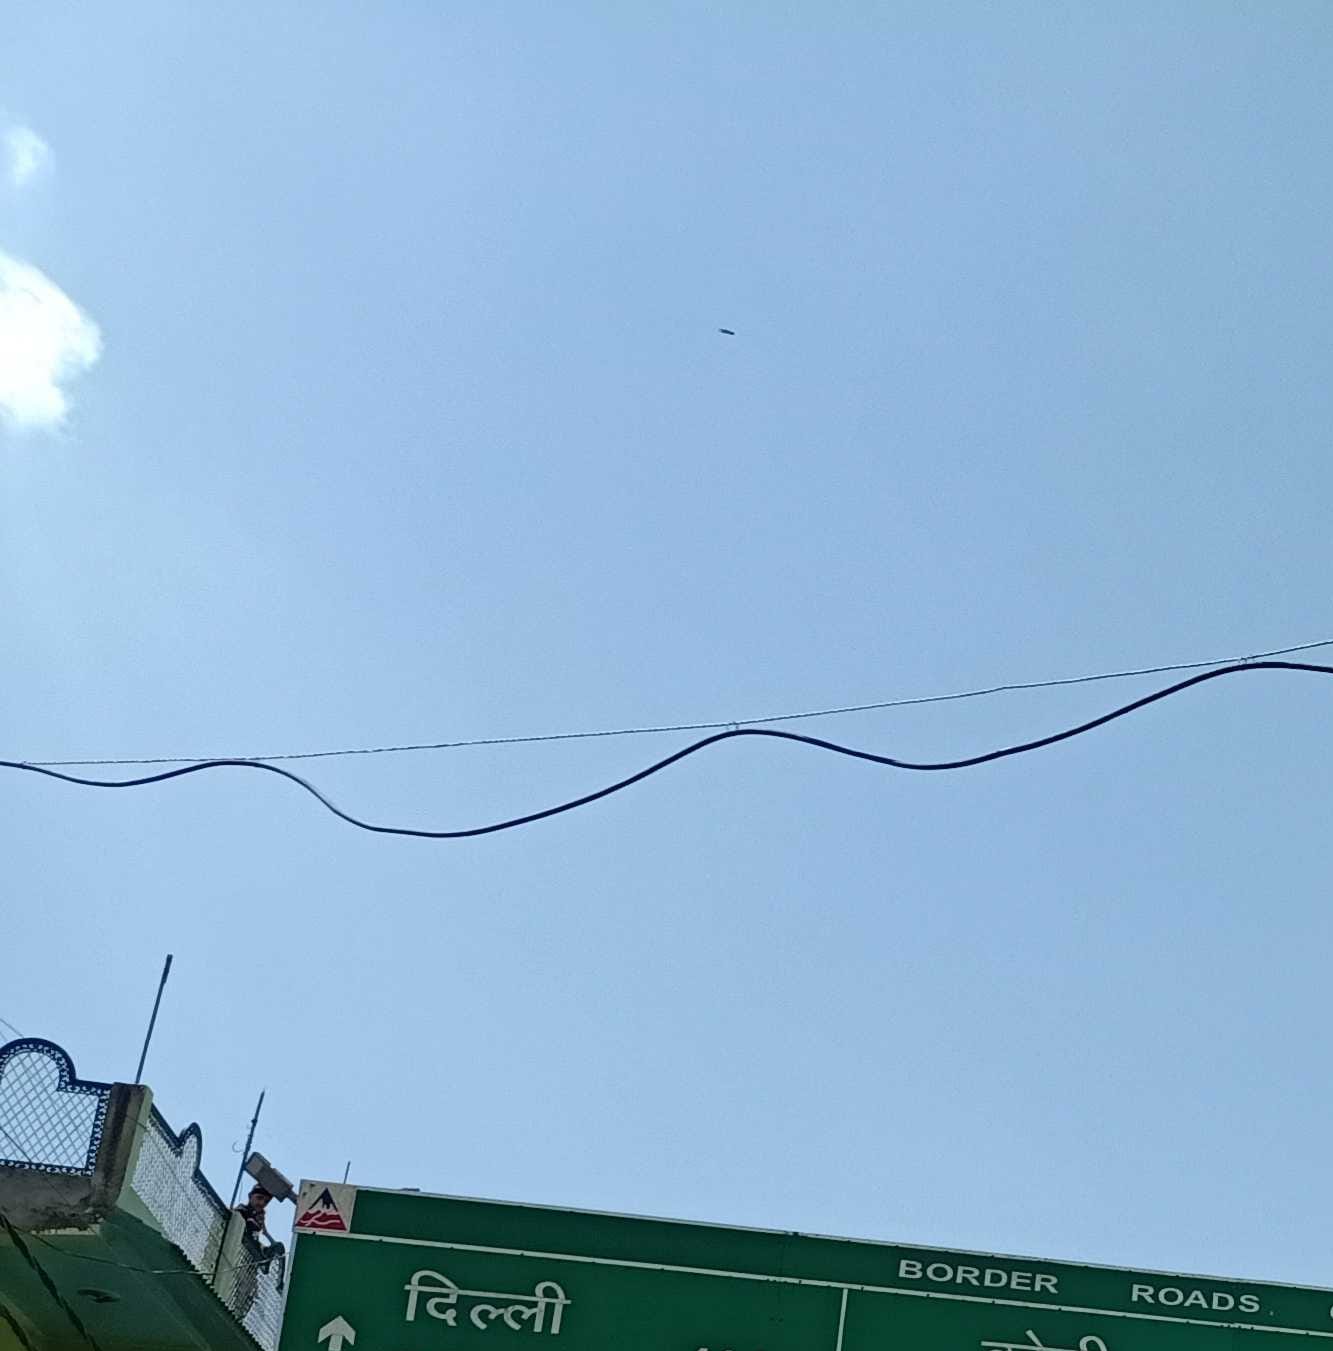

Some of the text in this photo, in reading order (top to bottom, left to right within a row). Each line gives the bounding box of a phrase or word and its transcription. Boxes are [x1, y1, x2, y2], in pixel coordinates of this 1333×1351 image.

[402, 1268, 573, 1337] दिल्ली
[896, 1257, 1061, 1296] BORDER
[1131, 1283, 1260, 1314] ROADS
